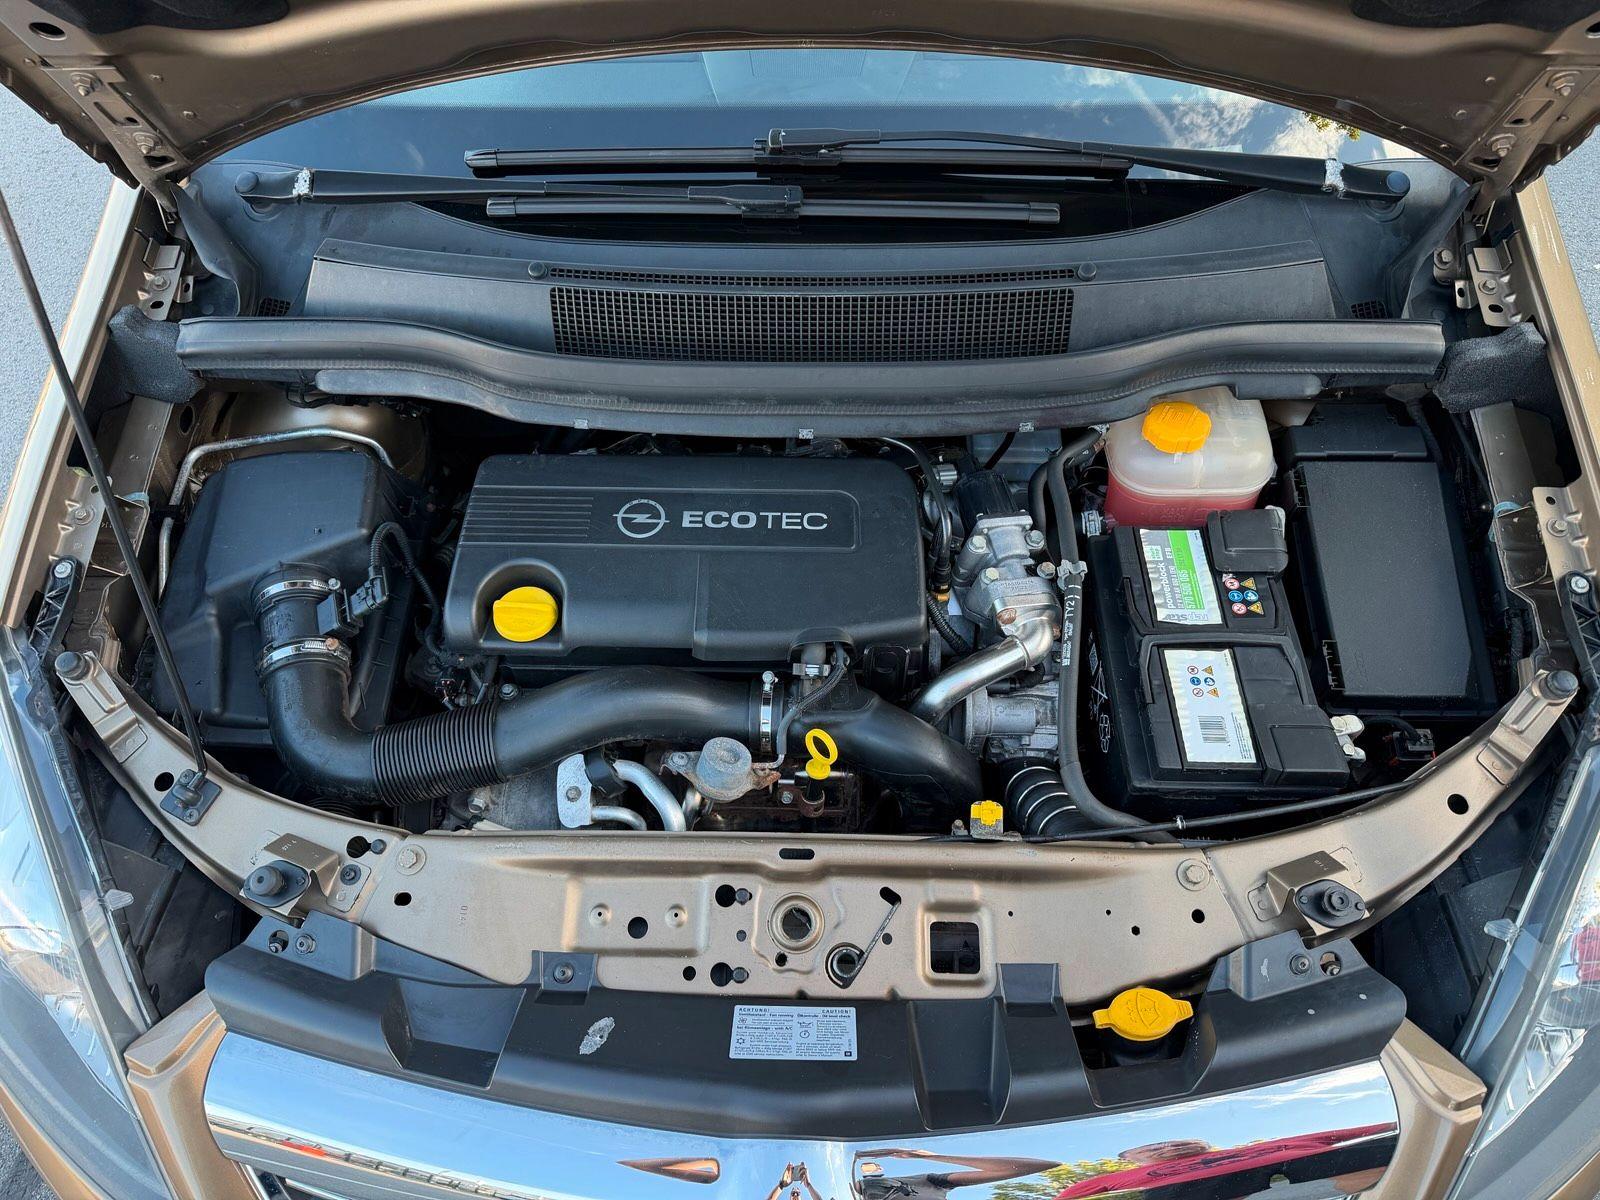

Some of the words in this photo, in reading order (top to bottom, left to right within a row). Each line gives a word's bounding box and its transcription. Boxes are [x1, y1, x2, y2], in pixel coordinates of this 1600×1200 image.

[681, 510, 828, 530] ECOTEC
[1179, 570, 1188, 581] 065
[1158, 563, 1175, 609] powerblock
[1182, 582, 1193, 594] 500
[1065, 600, 1075, 621] TY2
[1185, 597, 1195, 609] 570
